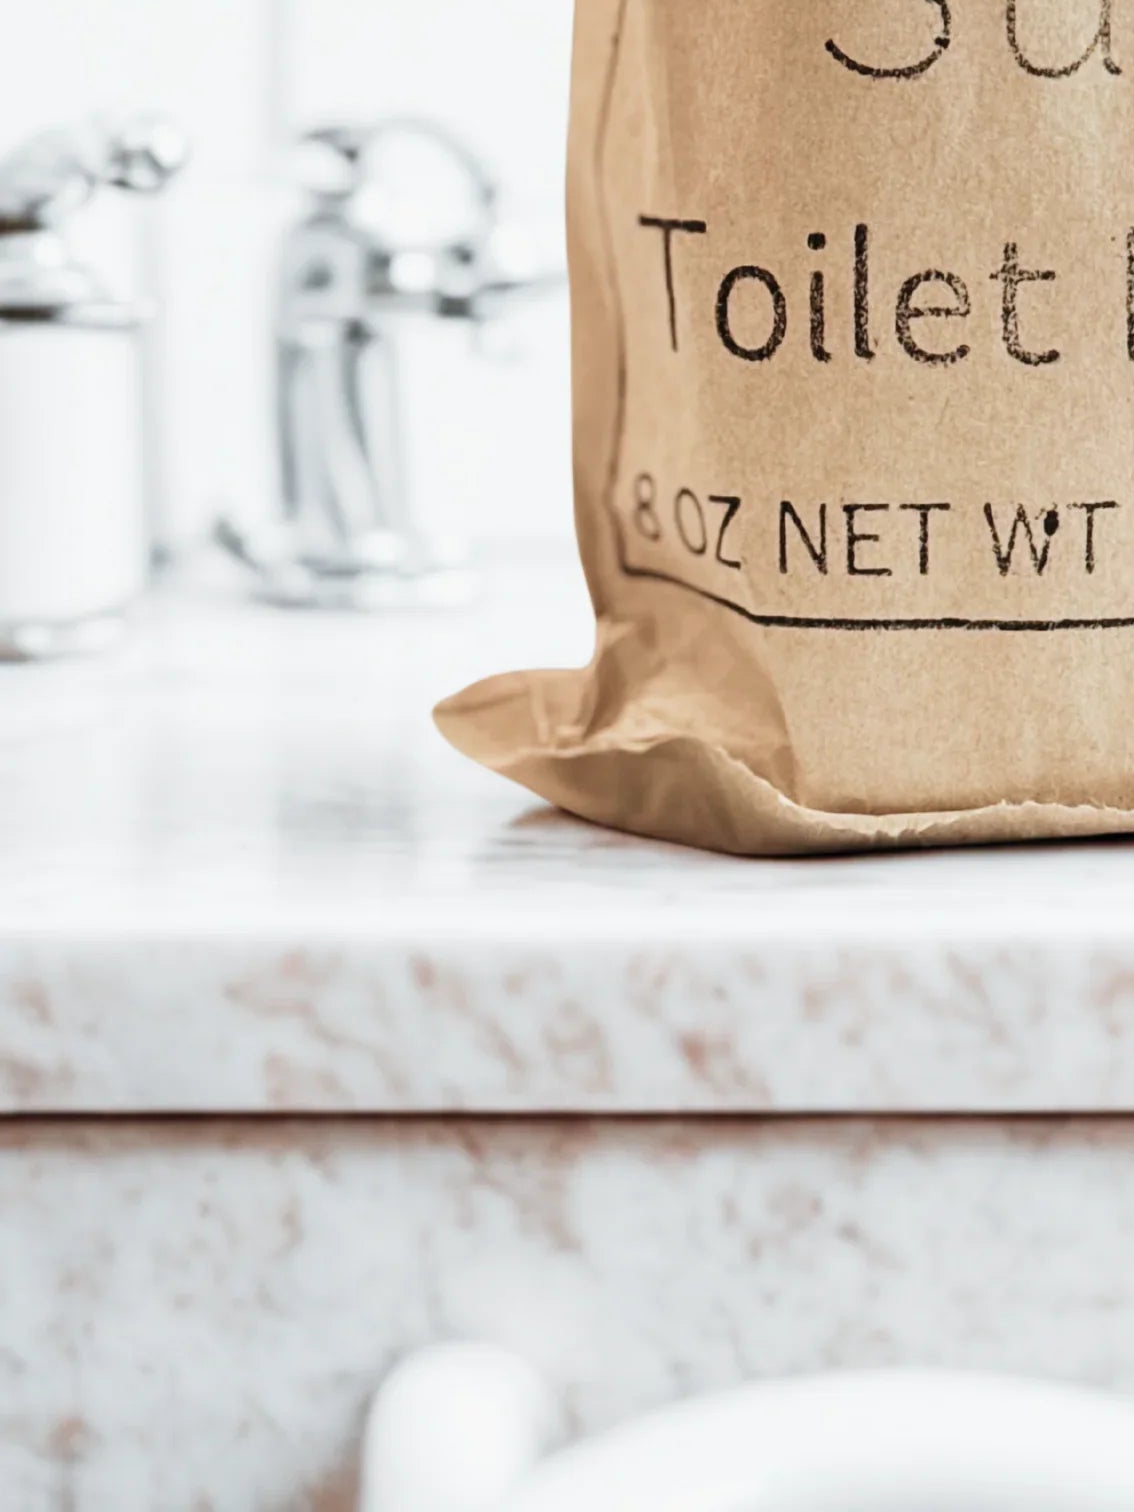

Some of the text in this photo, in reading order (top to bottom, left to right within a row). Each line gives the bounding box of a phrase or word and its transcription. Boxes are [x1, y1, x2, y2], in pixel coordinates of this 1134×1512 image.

[638, 214, 1060, 365] Toilet
[778, 499, 951, 577] NET
[983, 499, 1119, 578] WT
